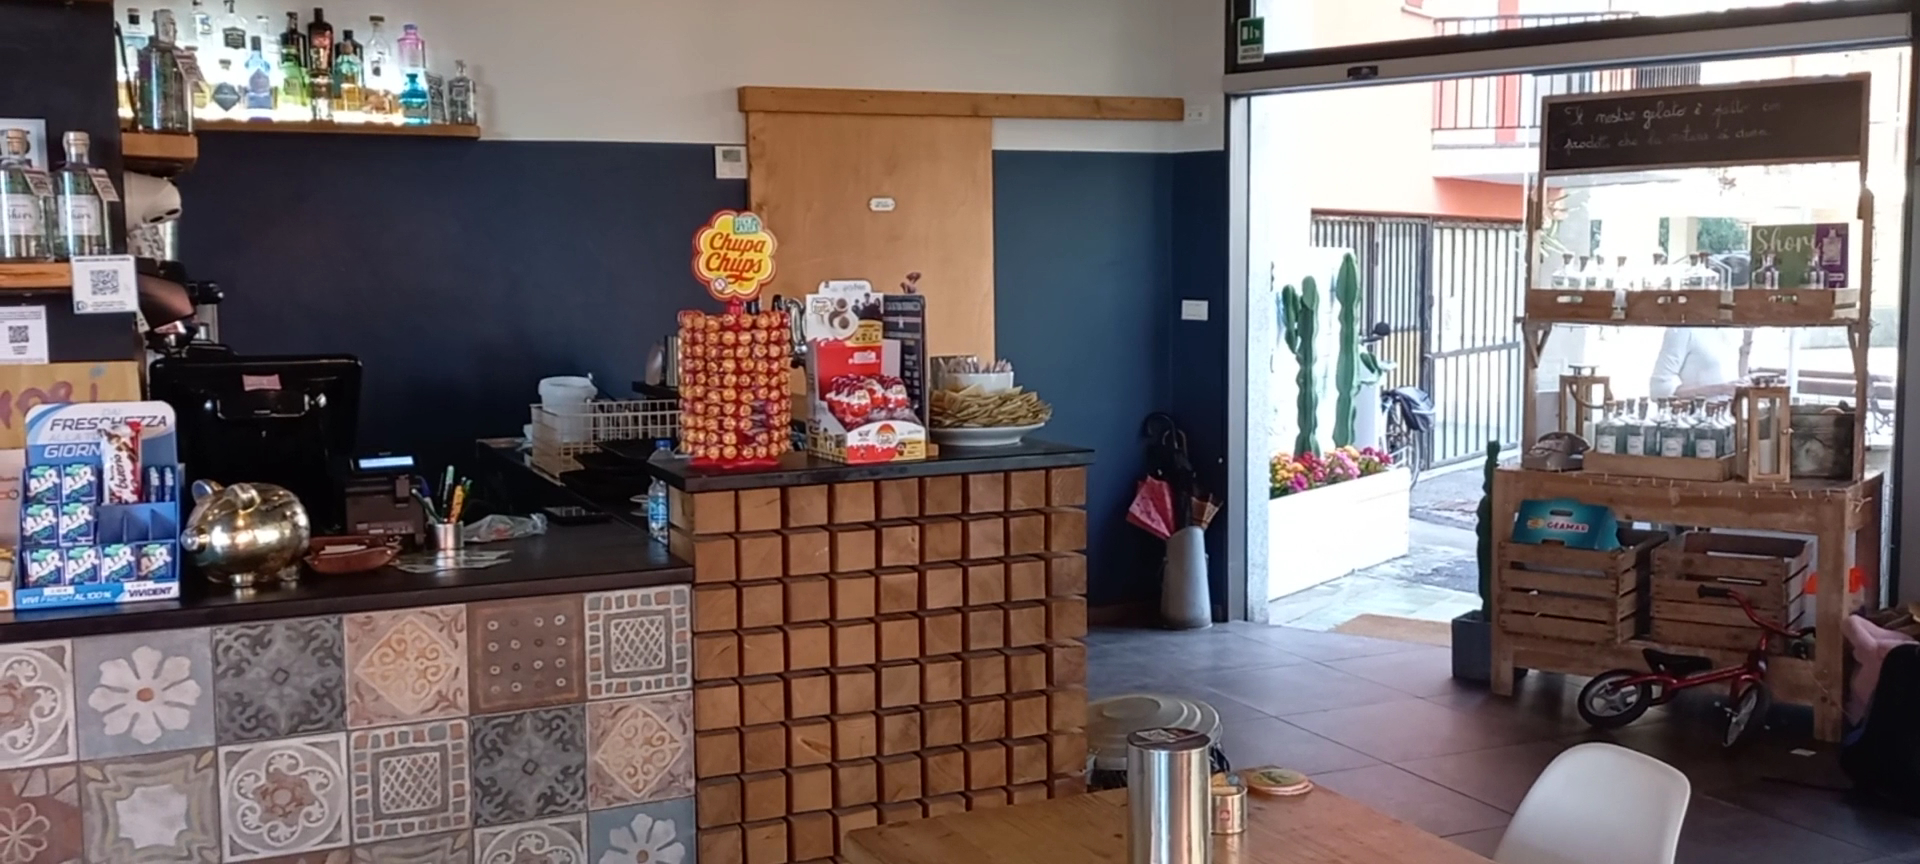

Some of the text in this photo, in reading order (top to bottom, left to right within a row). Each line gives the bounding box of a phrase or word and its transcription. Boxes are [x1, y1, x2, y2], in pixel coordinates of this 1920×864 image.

[1643, 100, 1687, 129] gelato
[709, 232, 766, 257] Chupa
[1756, 227, 1821, 254] Shori
[705, 252, 763, 283] Chups
[44, 444, 100, 458] GIORN
[87, 591, 112, 600] 100%
[128, 586, 173, 598] VIVIDENT
